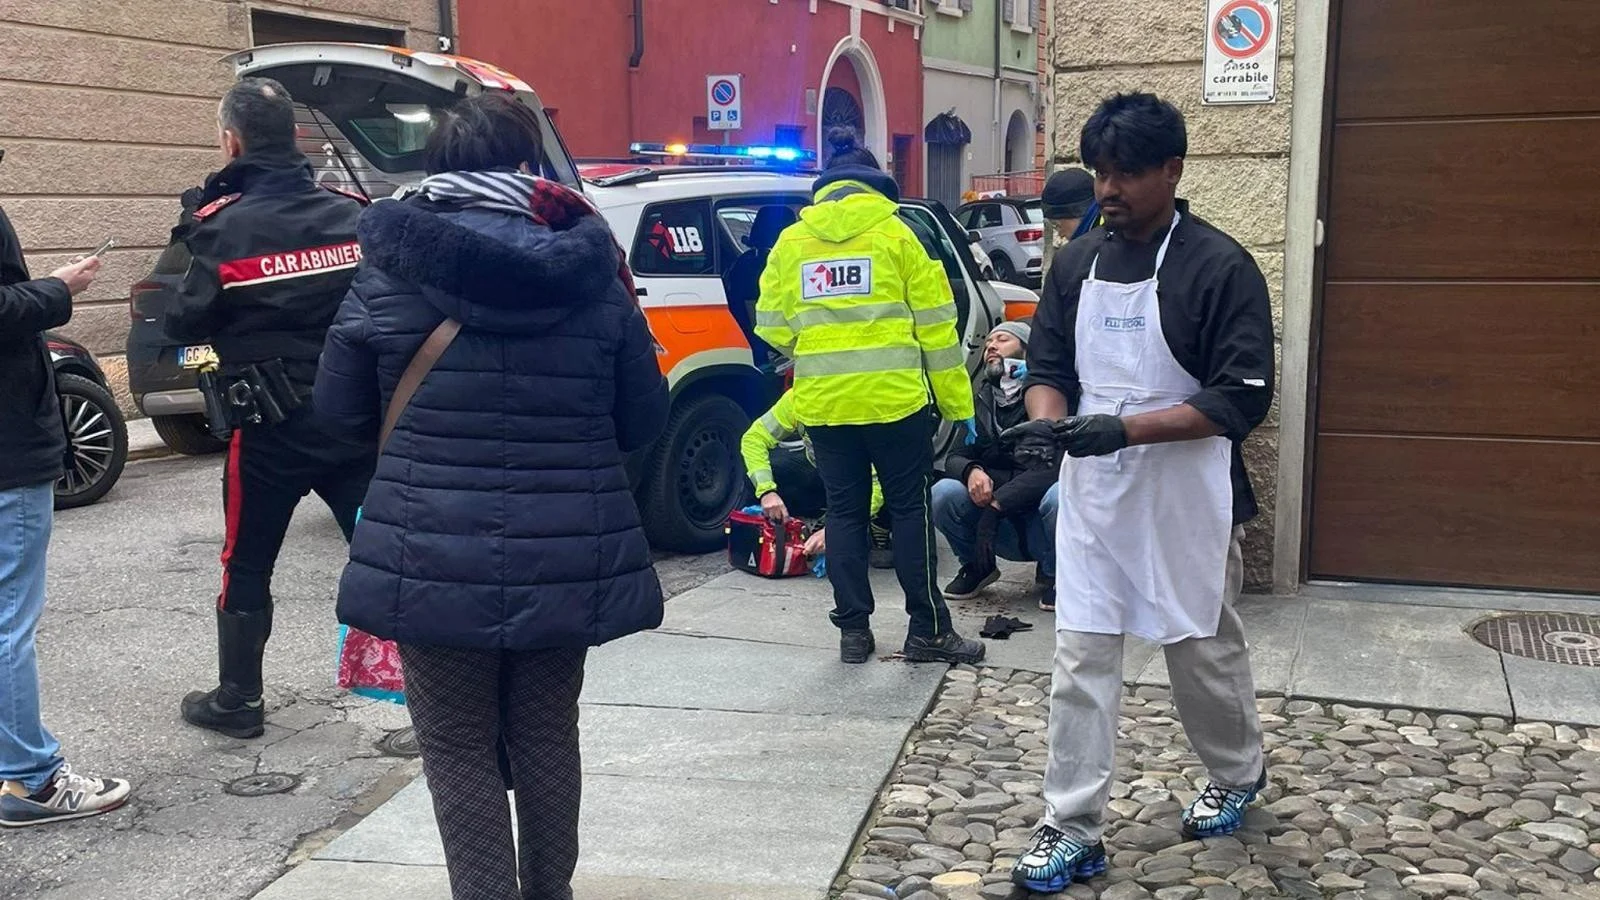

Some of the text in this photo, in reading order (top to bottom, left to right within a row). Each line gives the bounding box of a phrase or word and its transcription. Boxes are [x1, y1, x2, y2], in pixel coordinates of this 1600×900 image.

[1224, 62, 1259, 73] passo
[1213, 72, 1268, 83] carrabile
[667, 226, 703, 253] 118
[260, 244, 363, 275] CARABINIER
[830, 265, 861, 287] 118
[186, 347, 199, 362] GG
